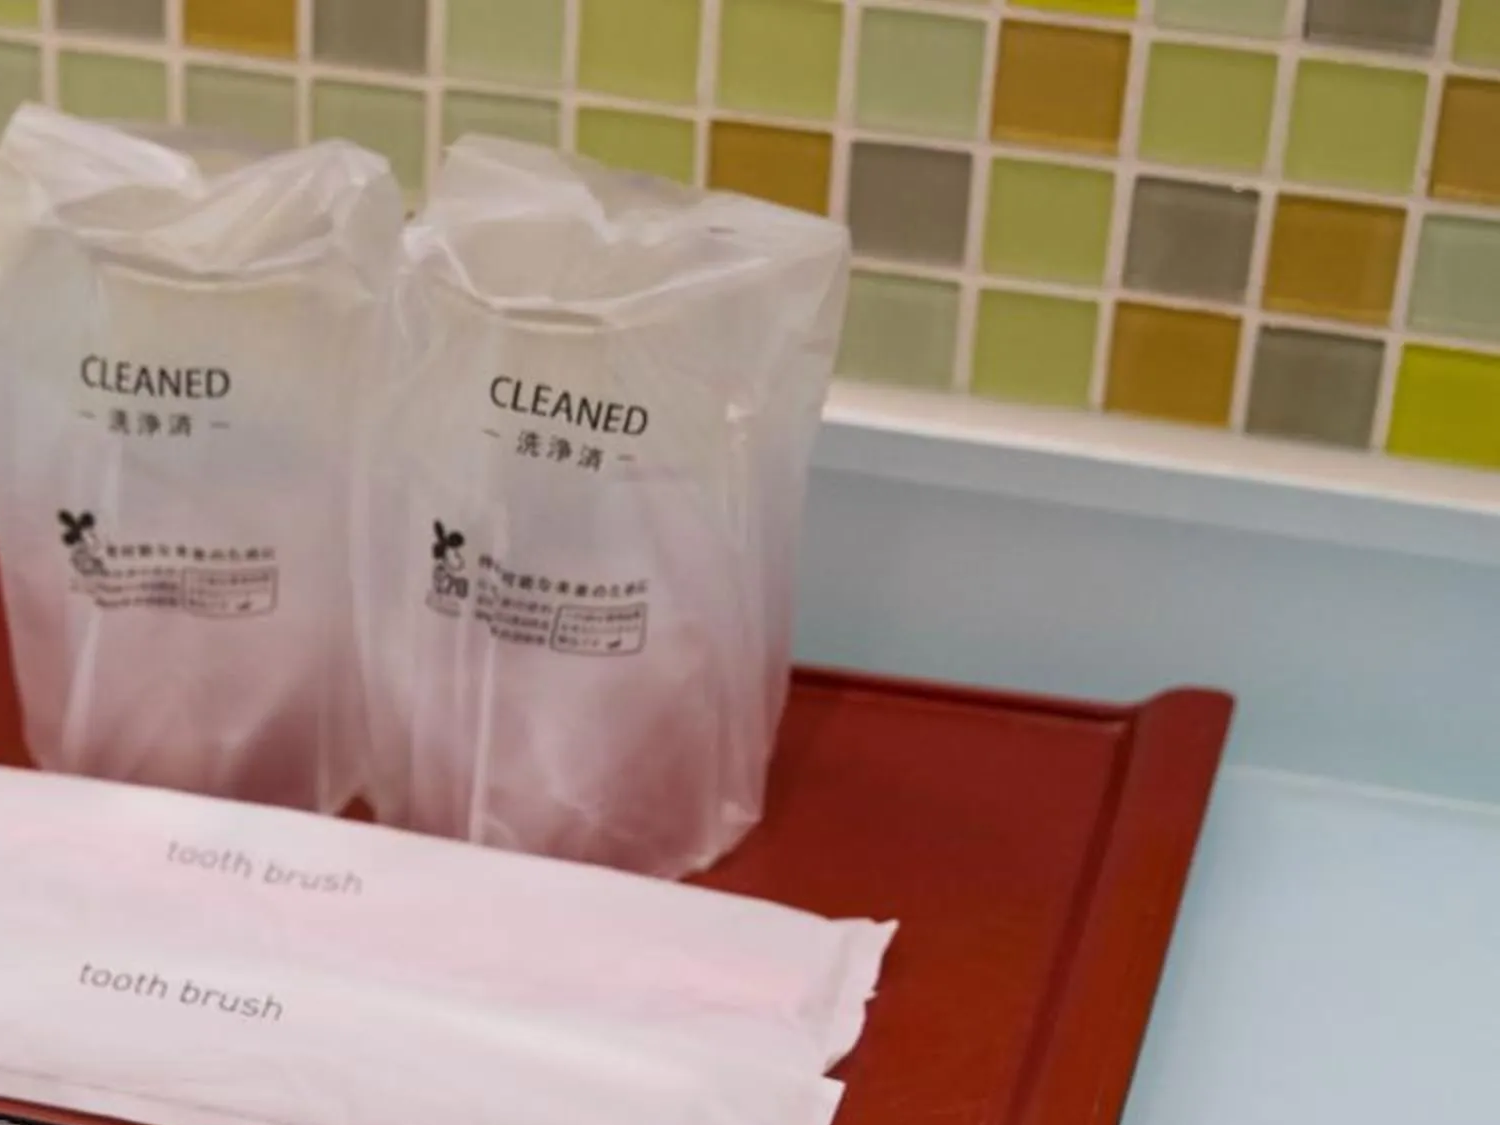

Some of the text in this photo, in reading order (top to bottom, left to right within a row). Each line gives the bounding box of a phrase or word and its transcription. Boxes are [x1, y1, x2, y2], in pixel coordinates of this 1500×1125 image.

[80, 354, 231, 398] CLEANED
[489, 376, 648, 436] CLEANED
[167, 841, 363, 896] tooth brush
[79, 962, 285, 1022] tooth brush
